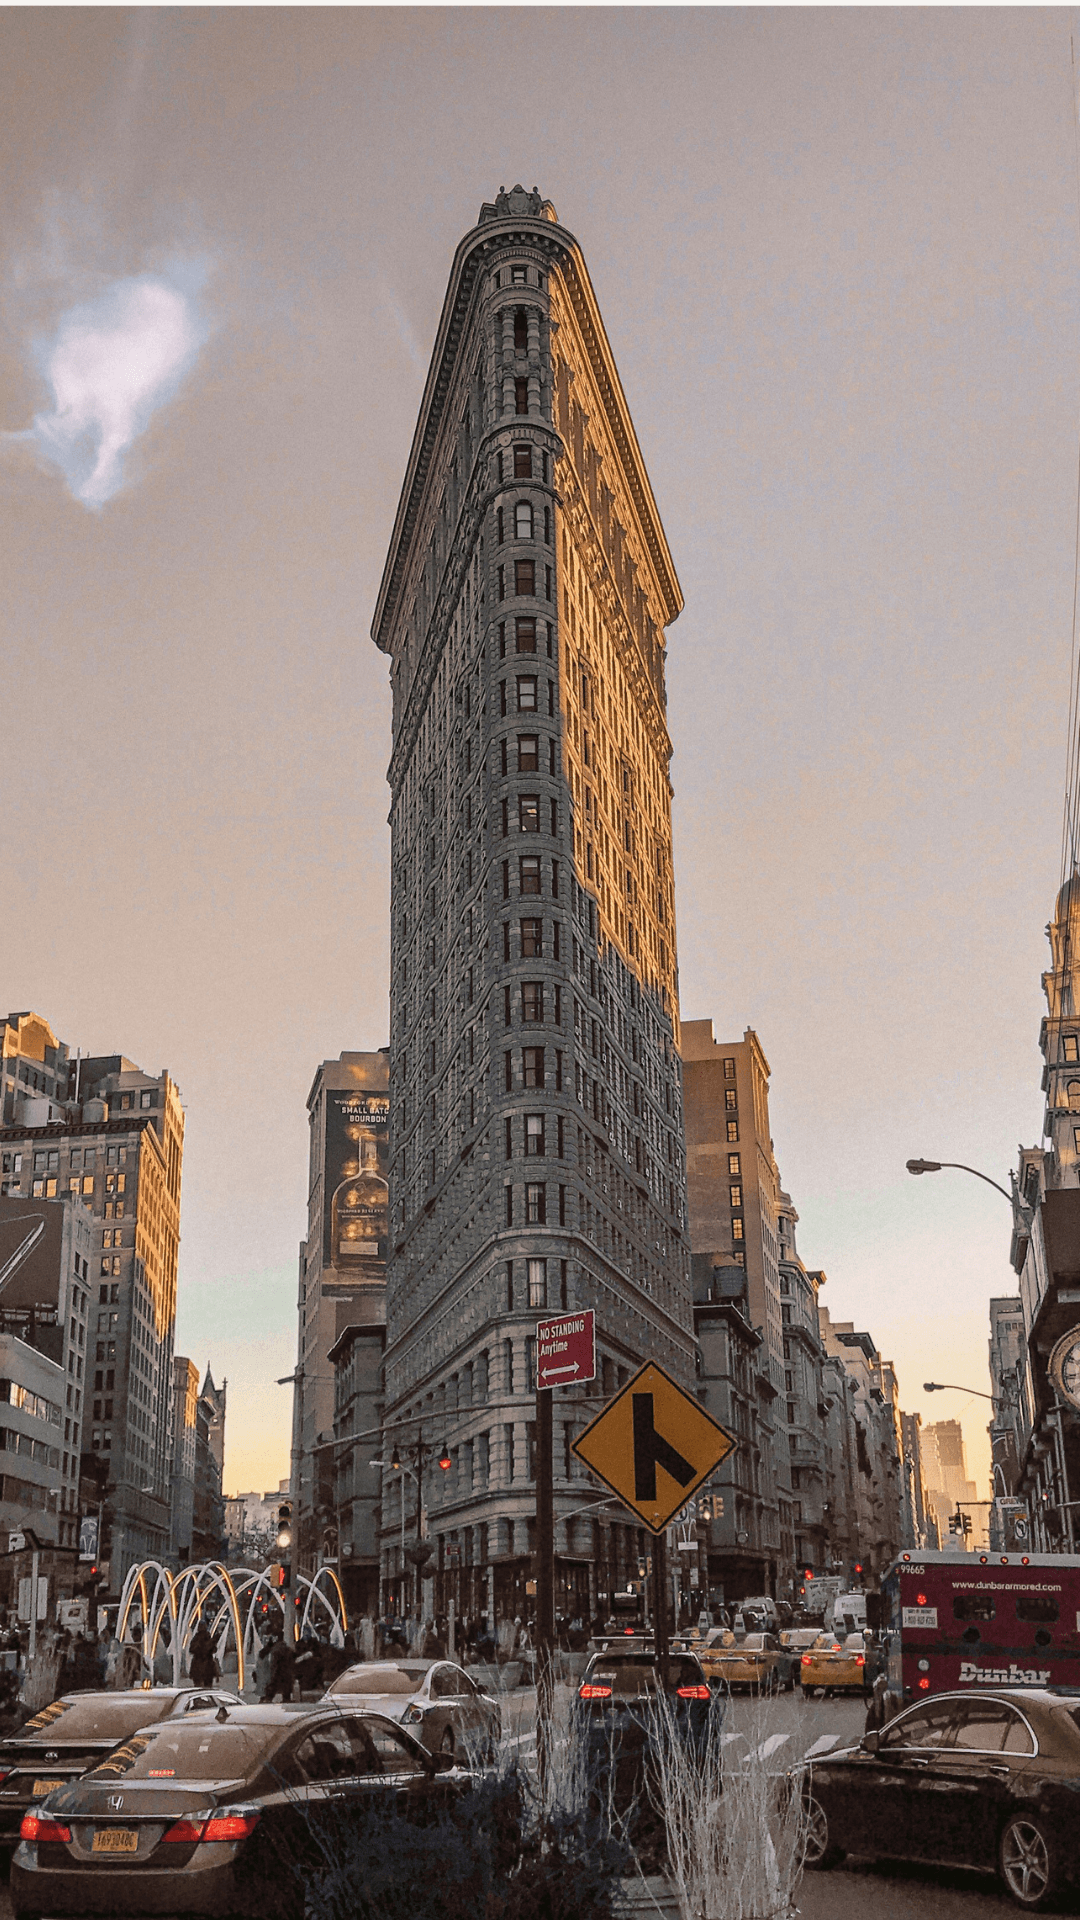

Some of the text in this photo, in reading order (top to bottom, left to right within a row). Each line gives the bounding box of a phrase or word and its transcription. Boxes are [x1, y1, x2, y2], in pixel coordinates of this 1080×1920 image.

[341, 1106, 367, 1114] SMALL
[349, 1115, 387, 1123] BOURBON
[540, 1319, 585, 1341] NO STANDING
[540, 1340, 569, 1358] Anytime
[900, 1564, 925, 1575] 99665
[952, 1581, 1062, 1592] www.dunbararmored.com
[958, 1662, 1051, 1685] Dunbar
